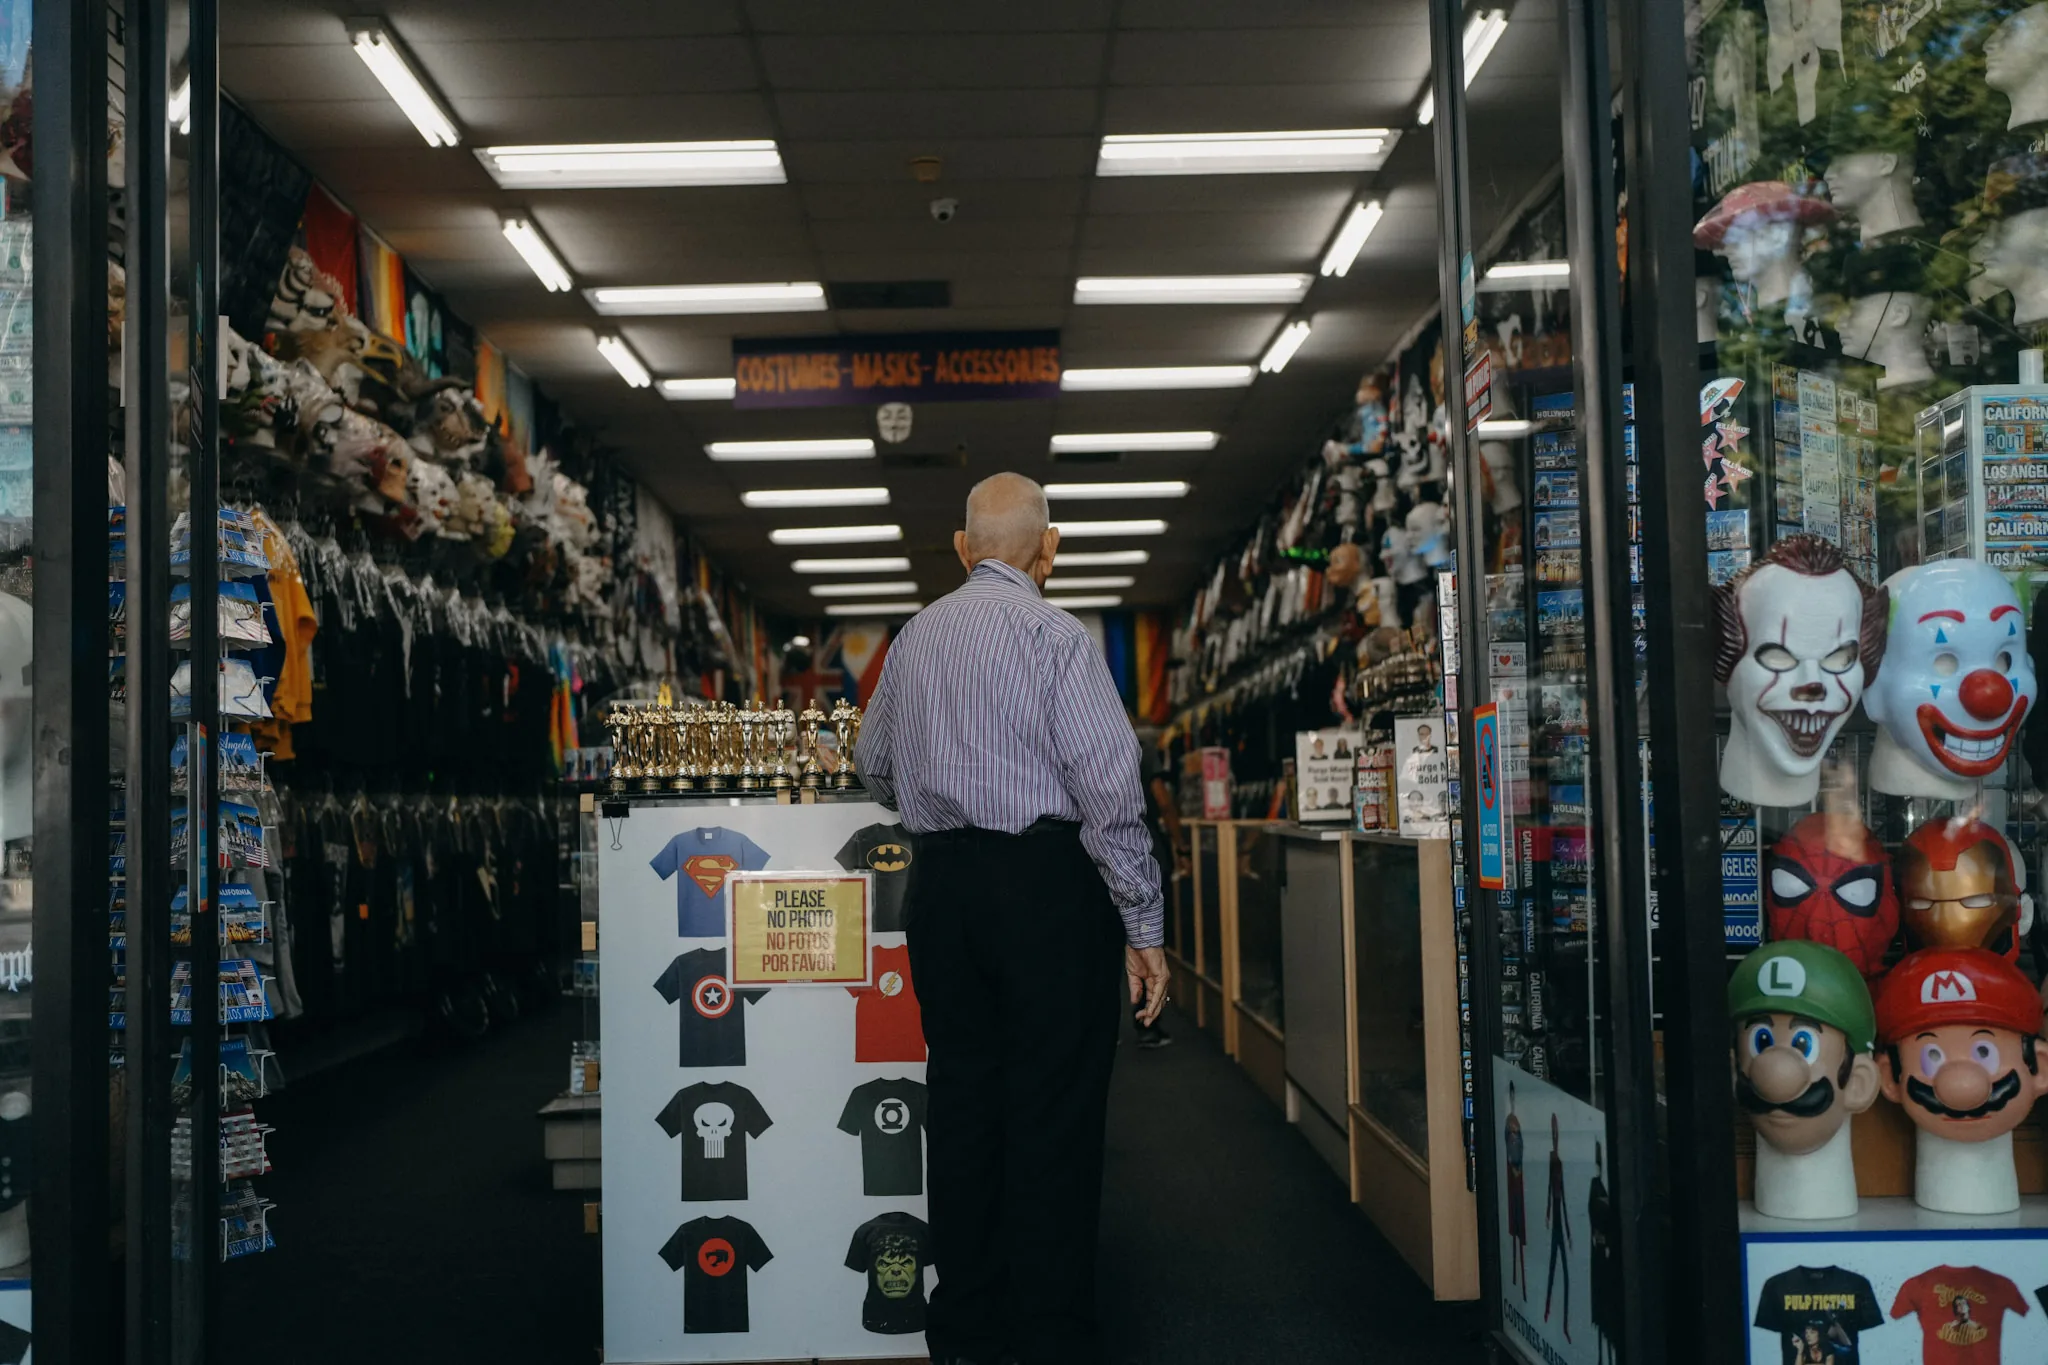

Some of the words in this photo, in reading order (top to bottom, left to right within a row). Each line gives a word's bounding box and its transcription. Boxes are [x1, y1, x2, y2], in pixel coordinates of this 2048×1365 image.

[853, 352, 922, 388] MASKS
[1984, 465, 2007, 479] LOS
[1987, 552, 2010, 566] LOS
[1418, 774, 1439, 785] Sold
[775, 889, 826, 908] PLEASE
[767, 911, 786, 928] NO
[789, 909, 834, 928] PHOTO
[766, 931, 786, 950] NO
[788, 931, 831, 950] FOTOS
[762, 953, 789, 972] POR
[792, 953, 836, 972] FAVOR
[1770, 962, 1792, 989] L
[1931, 971, 1966, 1000] M
[1784, 1294, 1812, 1311] PULP
